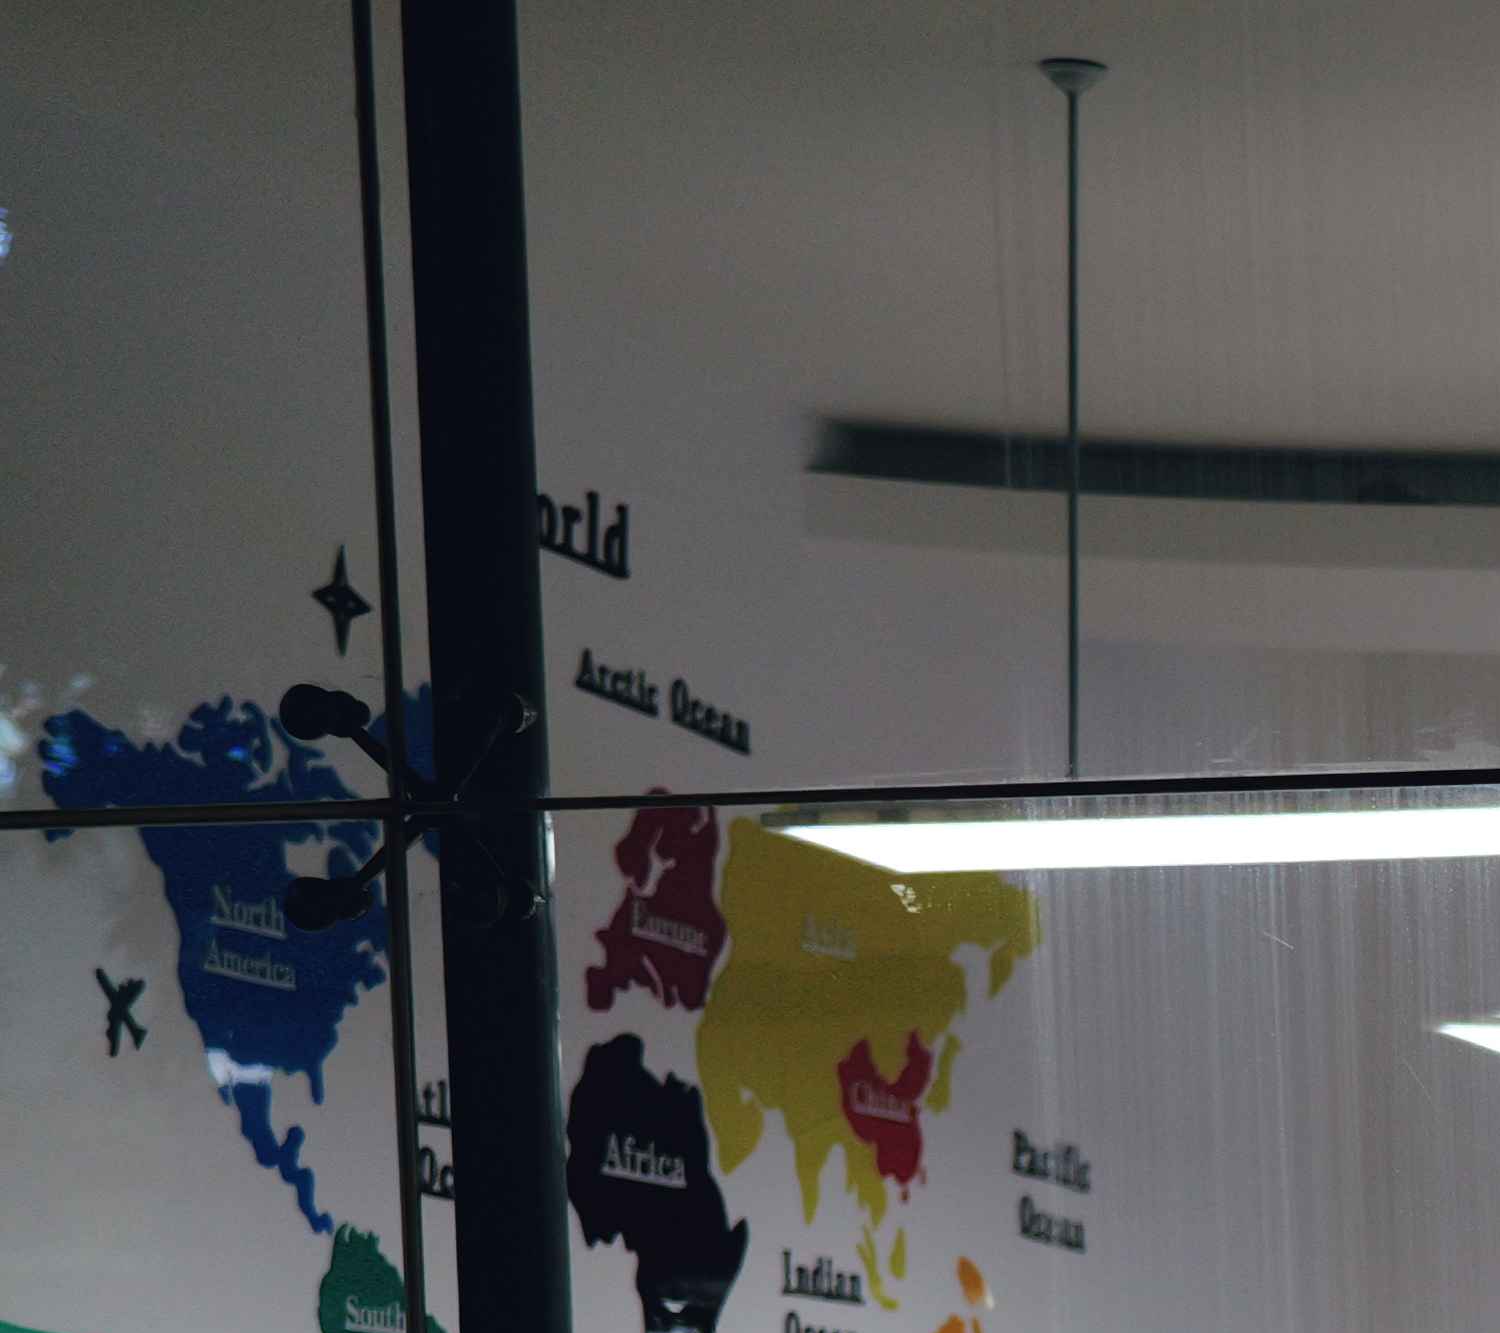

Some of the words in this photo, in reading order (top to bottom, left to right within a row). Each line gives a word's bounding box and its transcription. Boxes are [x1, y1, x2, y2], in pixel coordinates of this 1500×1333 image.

[537, 490, 630, 580] orld
[573, 648, 660, 718] Arctic
[669, 678, 752, 756] Ocean
[209, 884, 287, 940] North
[202, 937, 298, 992] America
[600, 1132, 688, 1190] Africa
[782, 1247, 863, 1305] Indian
